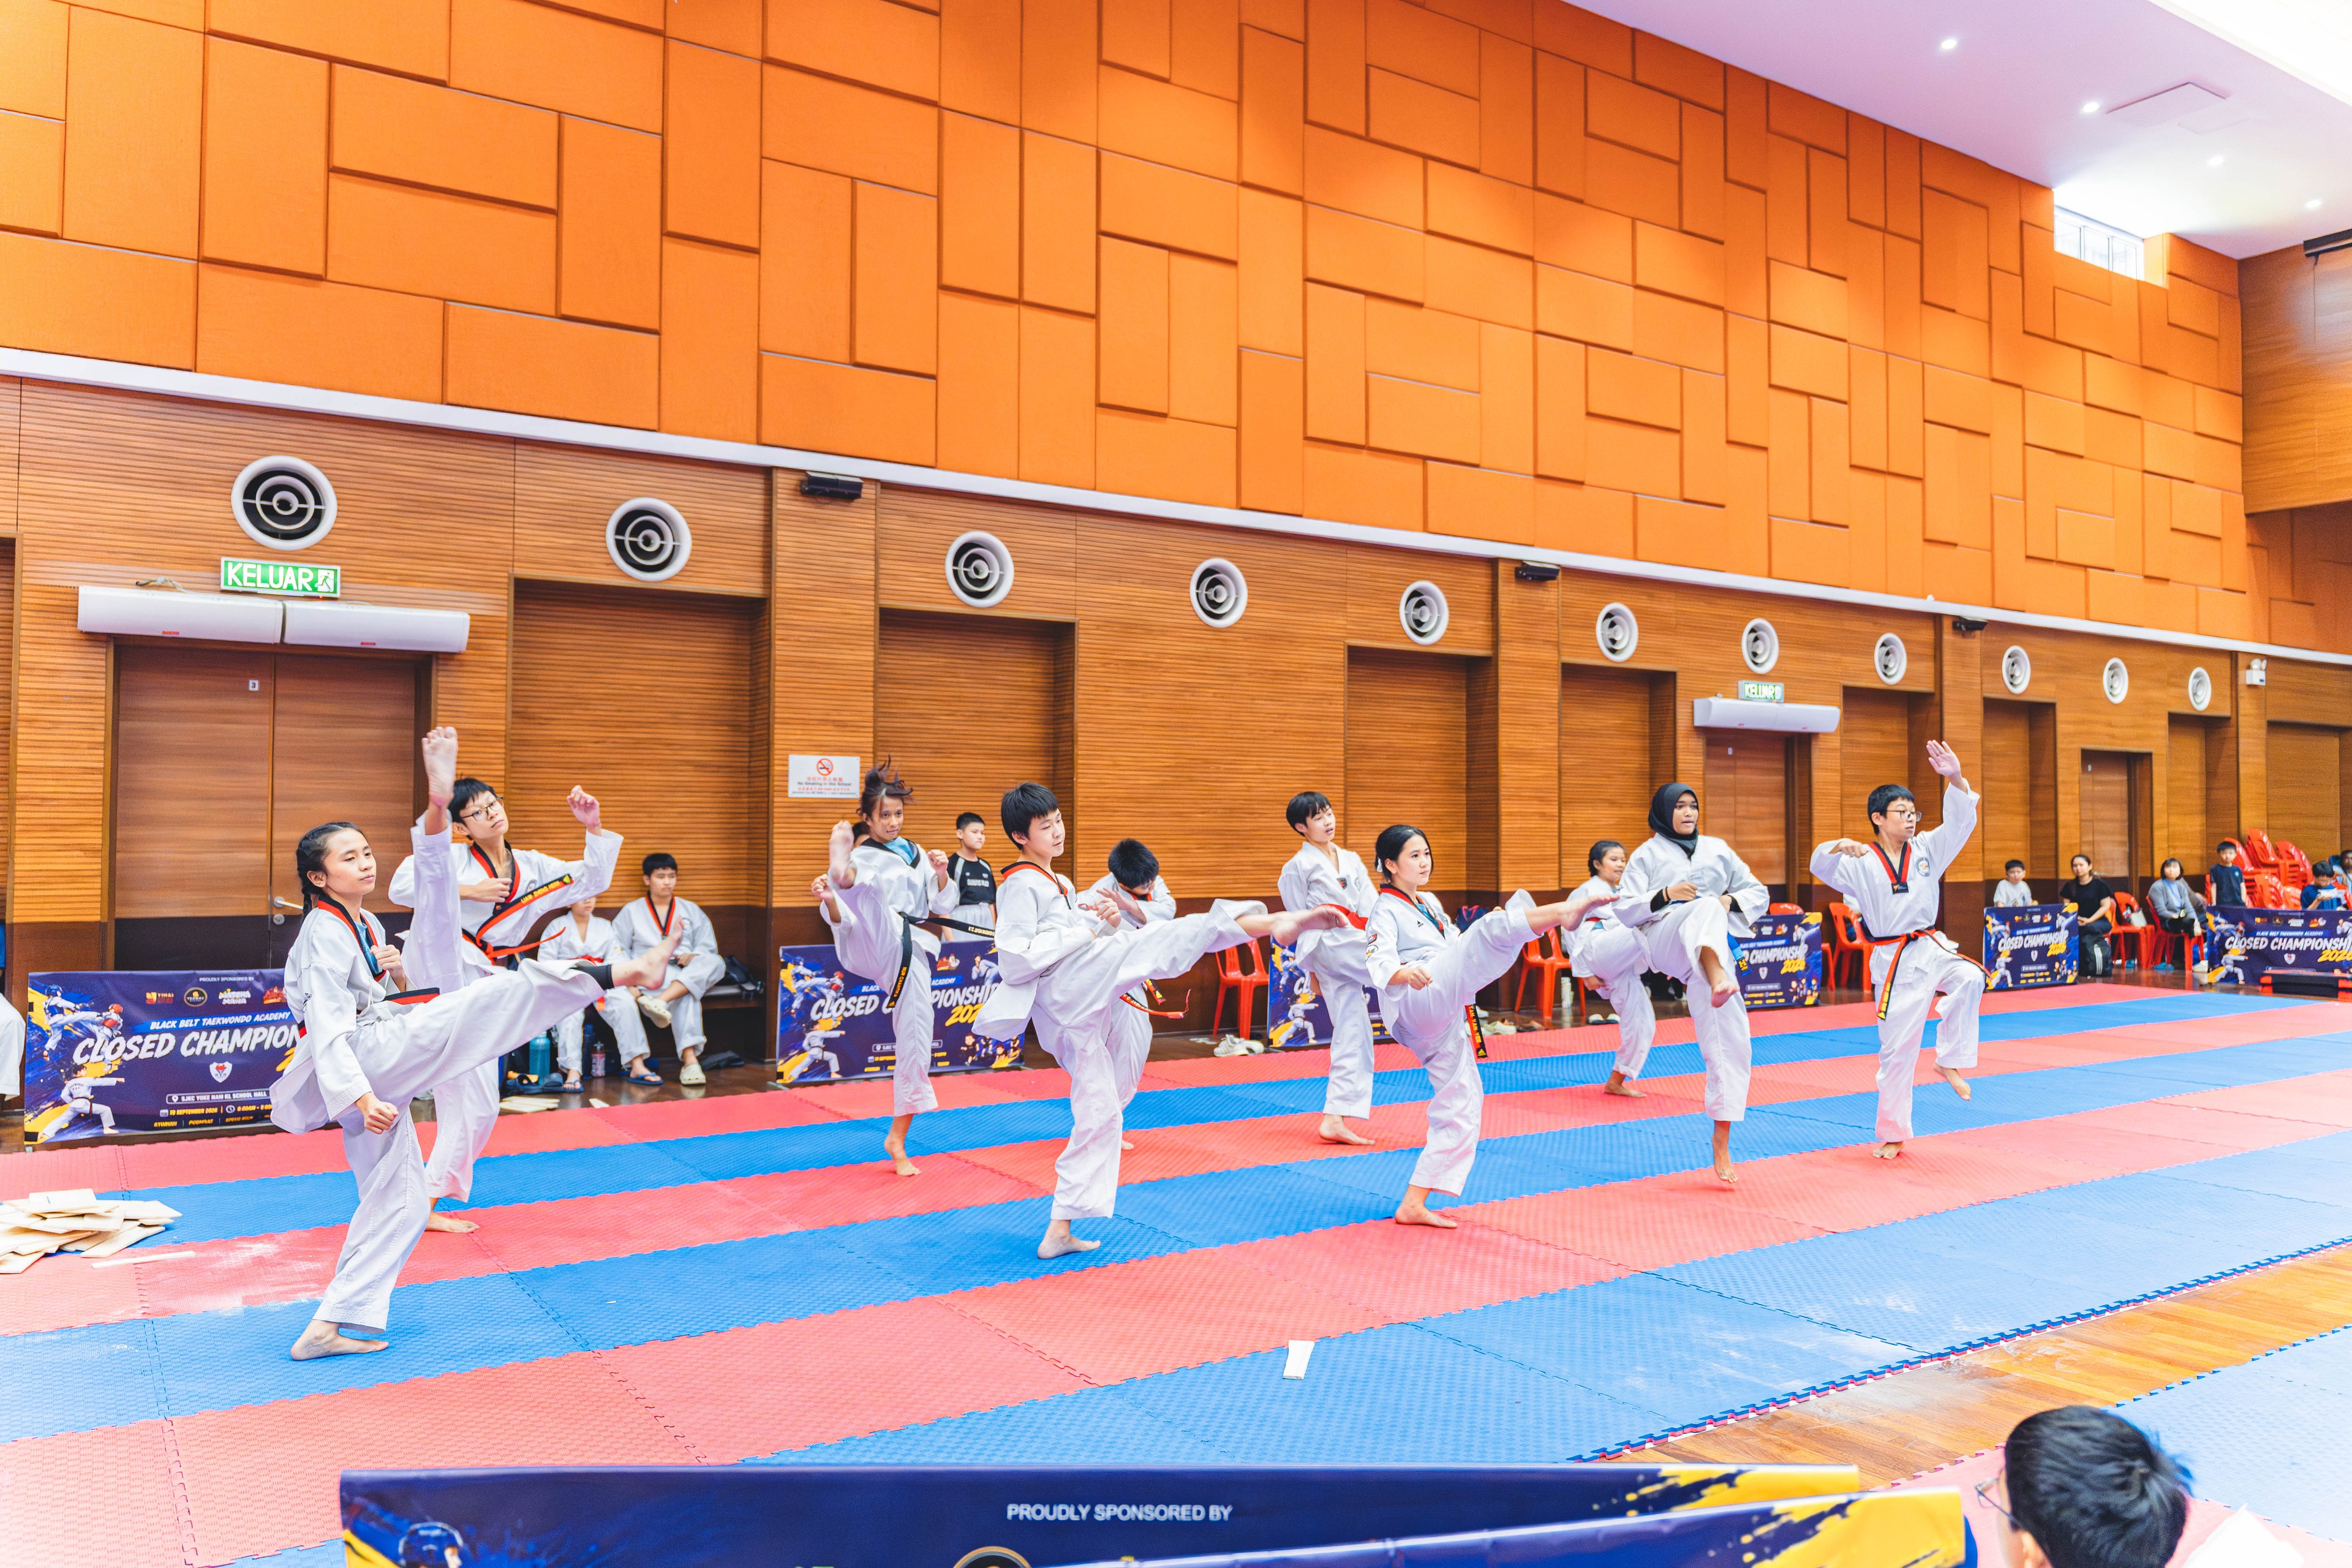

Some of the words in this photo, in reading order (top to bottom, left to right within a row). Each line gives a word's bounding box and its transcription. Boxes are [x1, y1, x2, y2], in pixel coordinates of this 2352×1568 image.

[227, 562, 314, 592] KELUAR
[1745, 683, 1775, 699] KELUAR
[1998, 935, 2024, 952] CLOSED
[2023, 929, 2070, 949] CHAMPIONSHIP
[2225, 936, 2269, 950] CLOSED
[1749, 943, 1809, 965] CHAMPIONSHIP
[932, 978, 956, 986] ACADEMY
[810, 995, 880, 1021] CLOSED
[150, 1020, 176, 1030] BLACK
[179, 1018, 200, 1028] BELT
[202, 1015, 252, 1027] TAEKWONDO
[254, 1011, 291, 1022] ACADEMY
[72, 1032, 176, 1065] CLOSED
[1006, 1503, 1091, 1521] PROUDLY
[1093, 1504, 1205, 1521] SPONSORED
[1208, 1504, 1234, 1521] BY
